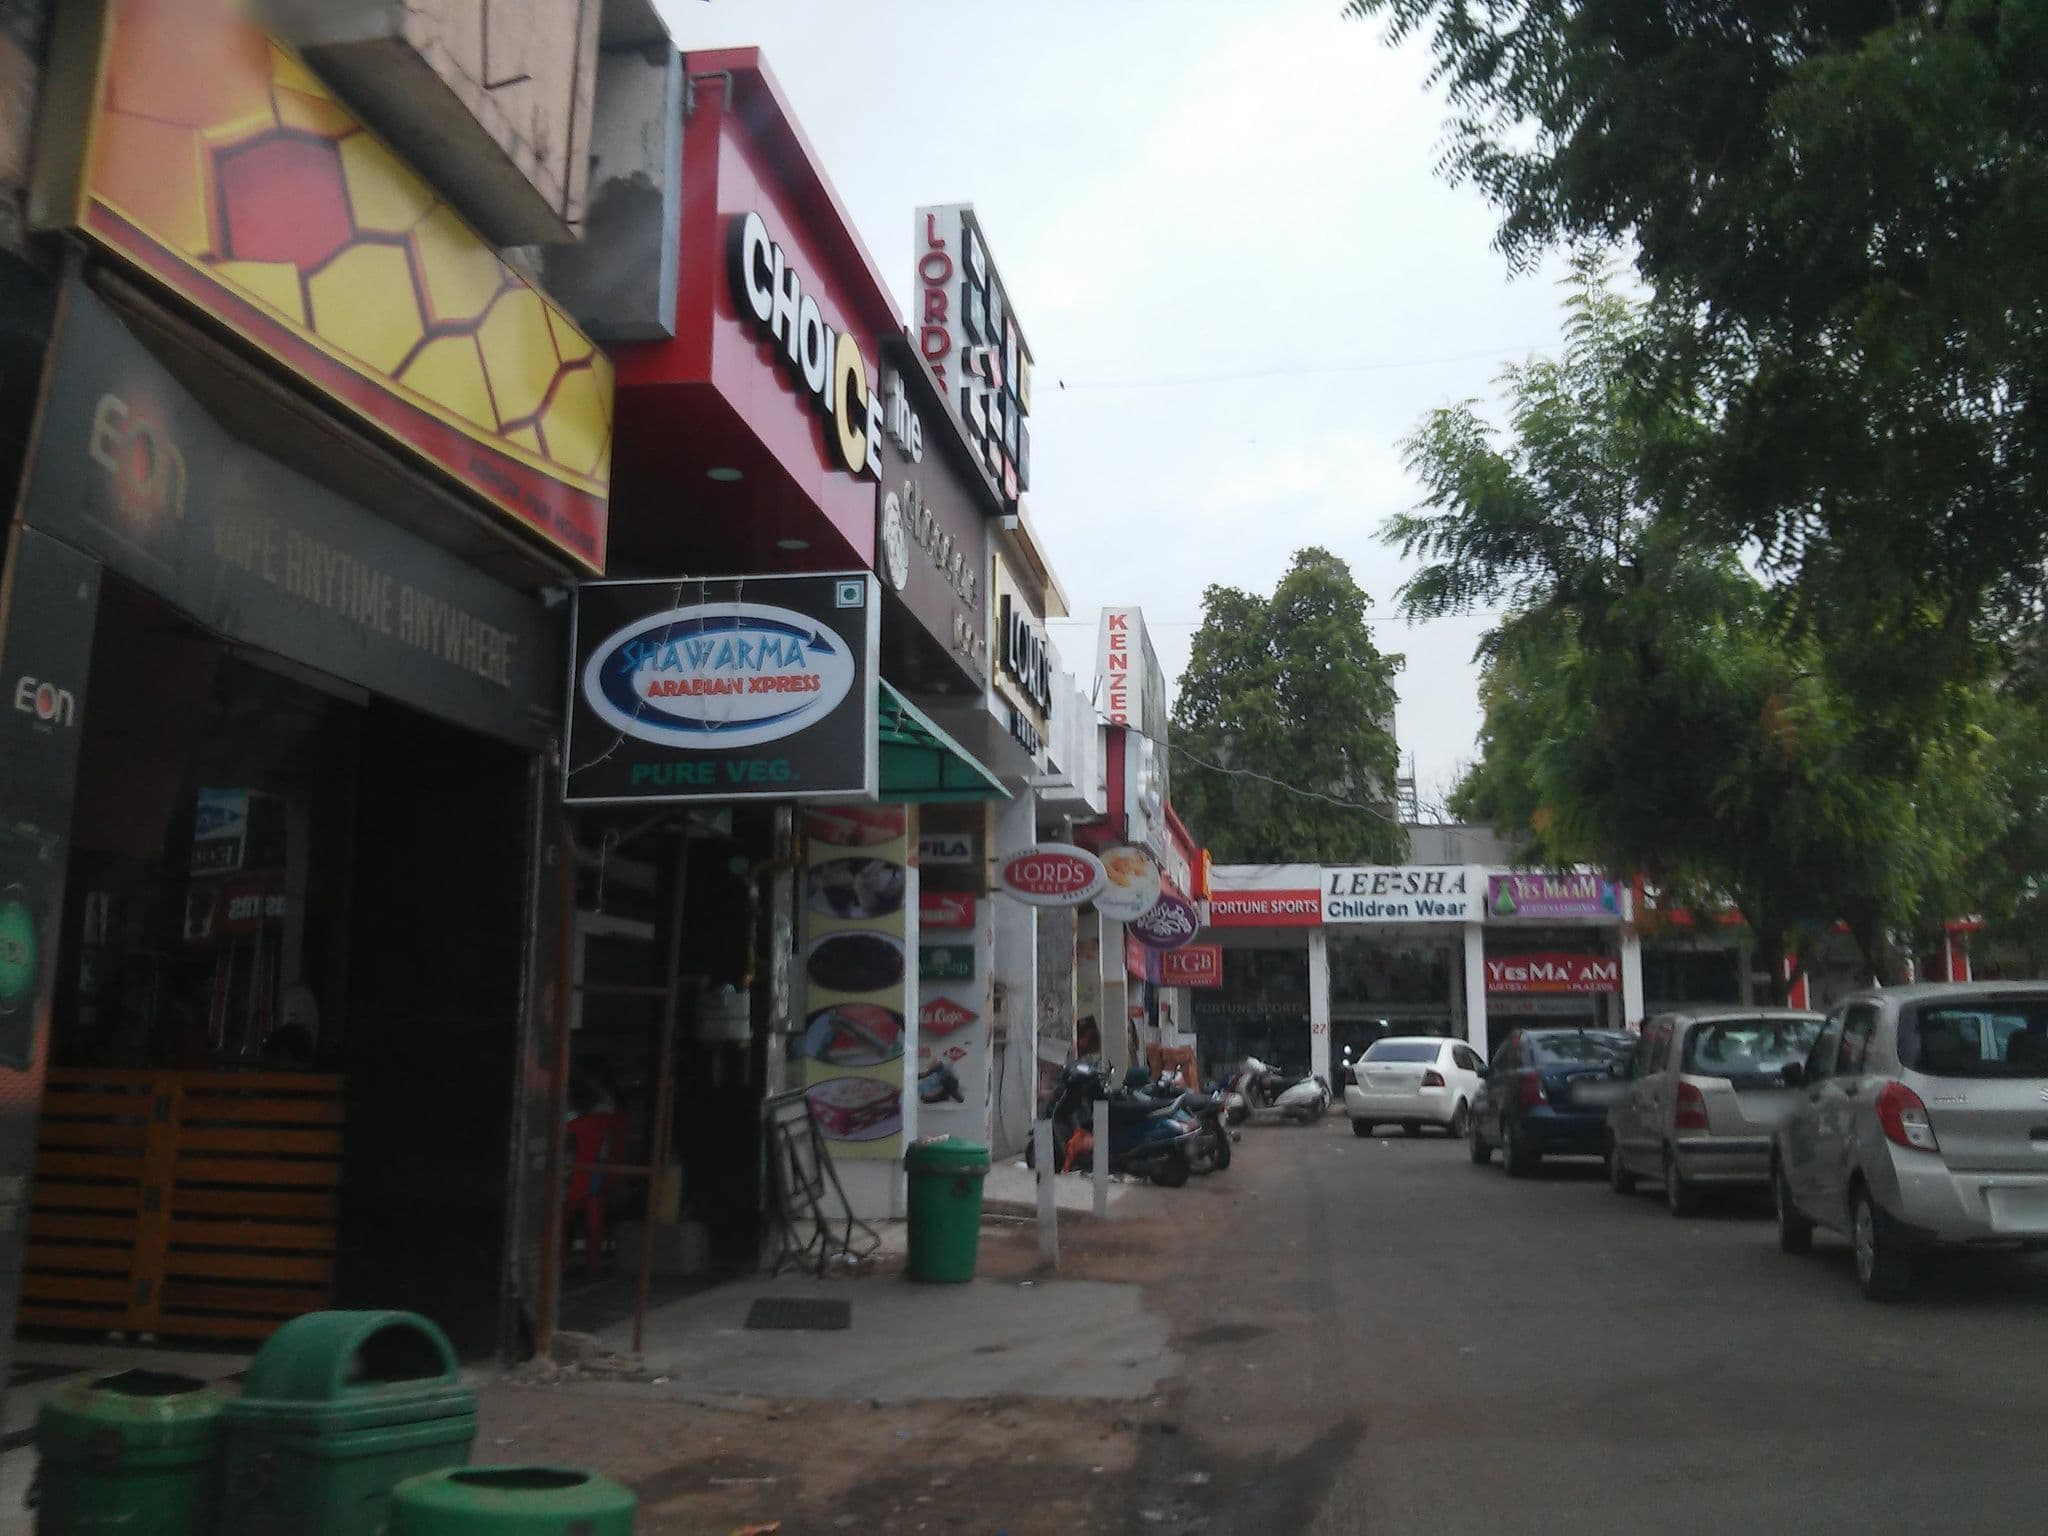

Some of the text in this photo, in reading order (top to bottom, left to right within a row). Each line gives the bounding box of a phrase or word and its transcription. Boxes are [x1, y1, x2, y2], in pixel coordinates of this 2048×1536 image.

[738, 212, 884, 482] CHOICE
[289, 530, 393, 635] ANYTIME
[399, 582, 515, 688] ANYWHERE
[619, 633, 807, 673] SHAWARMA
[647, 674, 822, 698] ARABIAN XPRESS
[630, 758, 801, 787] PURE VEG.
[1015, 858, 1085, 883] LORD'S
[1328, 871, 1467, 896] LEE-SHA
[1210, 899, 1319, 915] FORTUNE SPORTS
[1328, 900, 1467, 918] Children Wear
[1168, 951, 1212, 972] TGB
